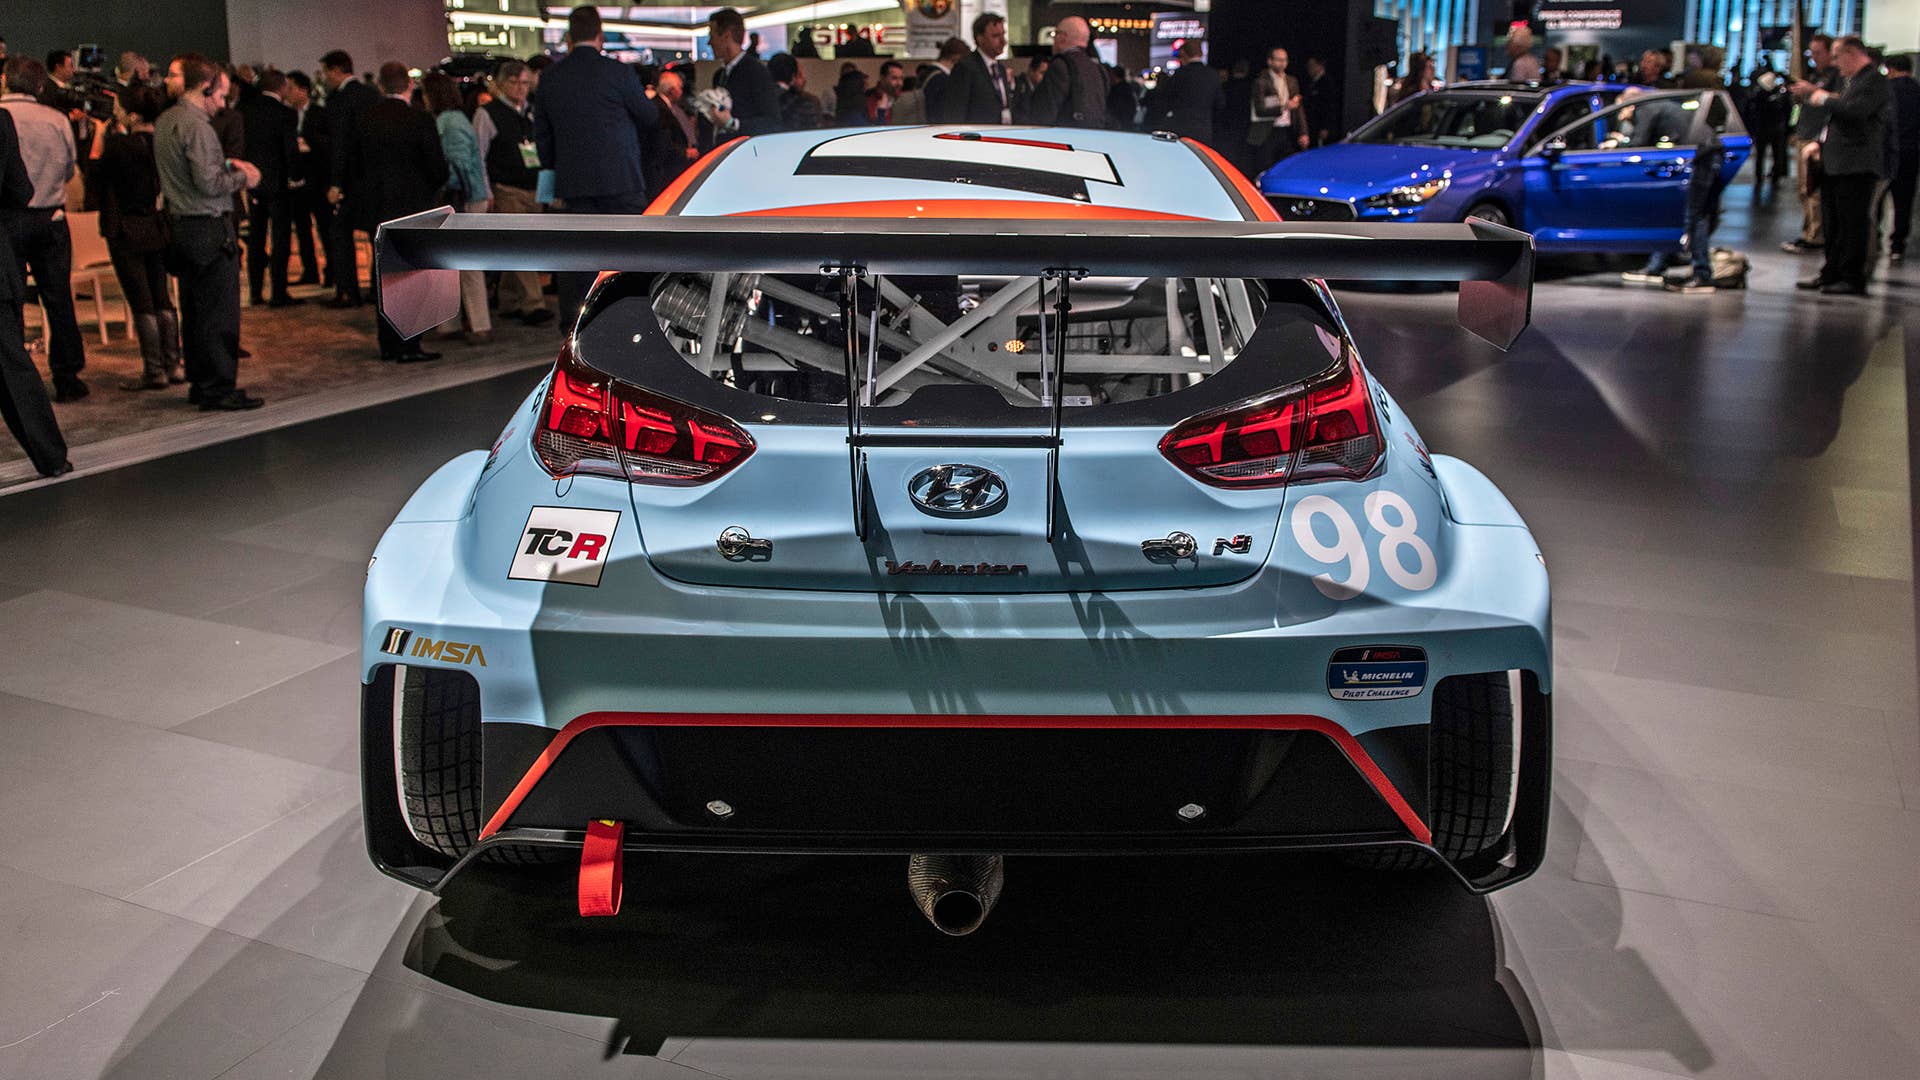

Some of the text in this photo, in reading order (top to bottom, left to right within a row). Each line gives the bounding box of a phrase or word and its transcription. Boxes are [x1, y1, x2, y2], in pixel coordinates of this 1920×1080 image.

[524, 527, 607, 561] TCR
[1291, 490, 1438, 600] 98
[411, 636, 487, 667] IMSA
[1361, 672, 1414, 681] MICHELIN
